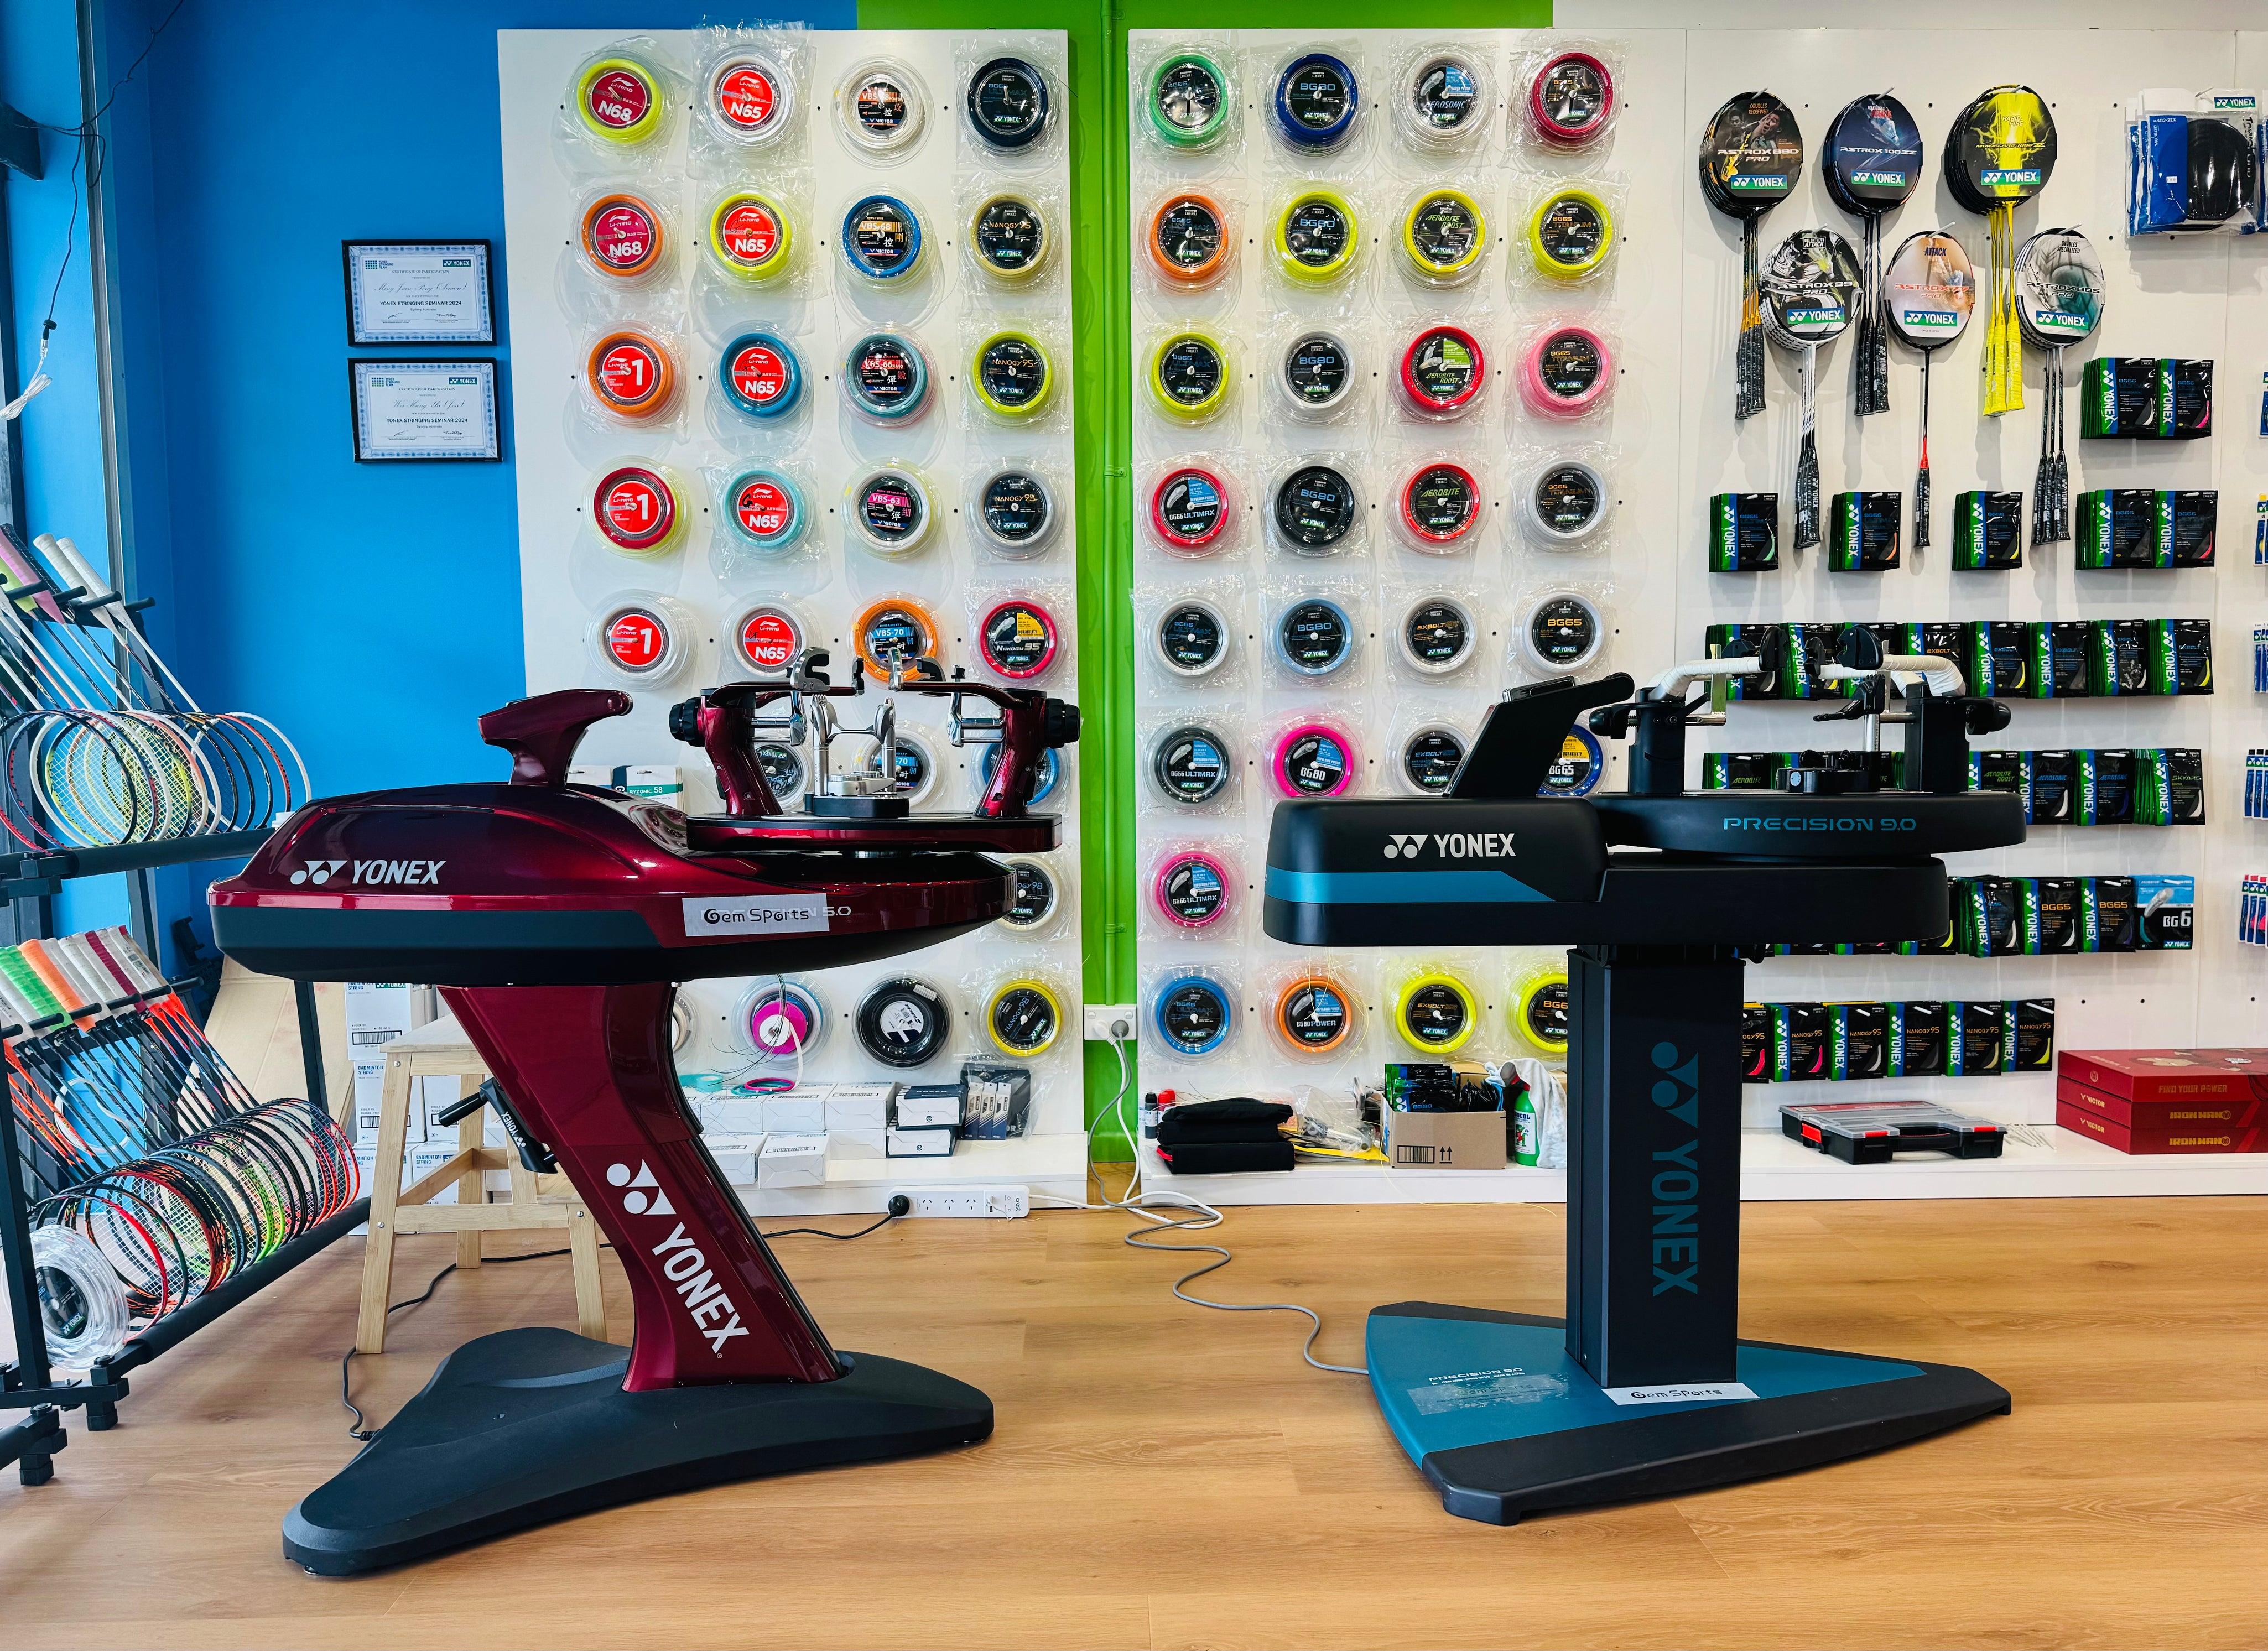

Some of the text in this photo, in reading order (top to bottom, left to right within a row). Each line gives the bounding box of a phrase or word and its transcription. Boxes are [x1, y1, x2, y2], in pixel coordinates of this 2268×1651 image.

[598, 100, 632, 121] N68
[730, 103, 762, 118] N65
[883, 107, 893, 117] 控
[1752, 177, 1784, 186] YONEX
[1872, 174, 1902, 184] YONEX
[2005, 171, 2037, 182] YONEX
[1300, 219, 1335, 228] BG80
[610, 241, 642, 257] N68
[735, 238, 766, 253] N65
[884, 237, 893, 247] 控
[1924, 247, 1947, 257] ATTACK
[1809, 310, 1841, 321] YONEX
[1924, 314, 1954, 324] YONEX
[2057, 315, 2085, 326] YONEX
[1299, 356, 1334, 364] BG80
[631, 359, 644, 386] 1
[745, 380, 776, 394] N65
[2104, 391, 2115, 421] YONEX
[2163, 391, 2173, 423] YONEX
[872, 495, 900, 505] VBS-63
[1301, 489, 1335, 502] BG80
[1421, 488, 1460, 497] AEROBITE
[636, 493, 648, 520] 1
[749, 515, 779, 528] N65
[1724, 524, 1735, 558] YONEX
[1849, 523, 1860, 556] YONEX
[1974, 522, 1983, 555] YONEX
[2099, 523, 2110, 554] YONEX
[2160, 523, 2172, 555] YONEX
[1298, 623, 1331, 631] BG80
[640, 628, 652, 654] 1
[755, 647, 786, 659] N65
[1796, 654, 1807, 685] YONEX
[1980, 653, 1991, 684] YONEX
[2040, 654, 2051, 685] YONEX
[2105, 652, 2116, 683] YONEX
[2164, 652, 2176, 683] YONEX
[1301, 767, 1325, 780] BG80
[2020, 782, 2030, 813] YONEX
[2083, 782, 2094, 813] YONEX
[2157, 782, 2169, 813] YONEX
[1724, 817, 1917, 831] PRECISION 9.0
[1433, 833, 1516, 858] YONEX
[351, 860, 446, 885] YONEX
[703, 908, 745, 924] Gem
[821, 905, 851, 917] 5.0
[1976, 910, 1989, 945] YONEX
[2027, 909, 2038, 944] YONEX
[2086, 908, 2096, 941] YONEX
[1778, 1038, 1787, 1070] YONEX
[1835, 1037, 1844, 1069] YONEX
[1891, 1034, 1902, 1065] YONEX
[1950, 1034, 1960, 1065] YONEX
[2004, 1030, 2015, 1060] YONEX
[2088, 1096, 2105, 1108] VICTOR
[2088, 1121, 2104, 1133] VICTOR
[1651, 1139, 1699, 1297] YONEX
[652, 1221, 750, 1353] YONEX
[1428, 1369, 1501, 1382] PRECISION
[1631, 1389, 1668, 1400] Gem
